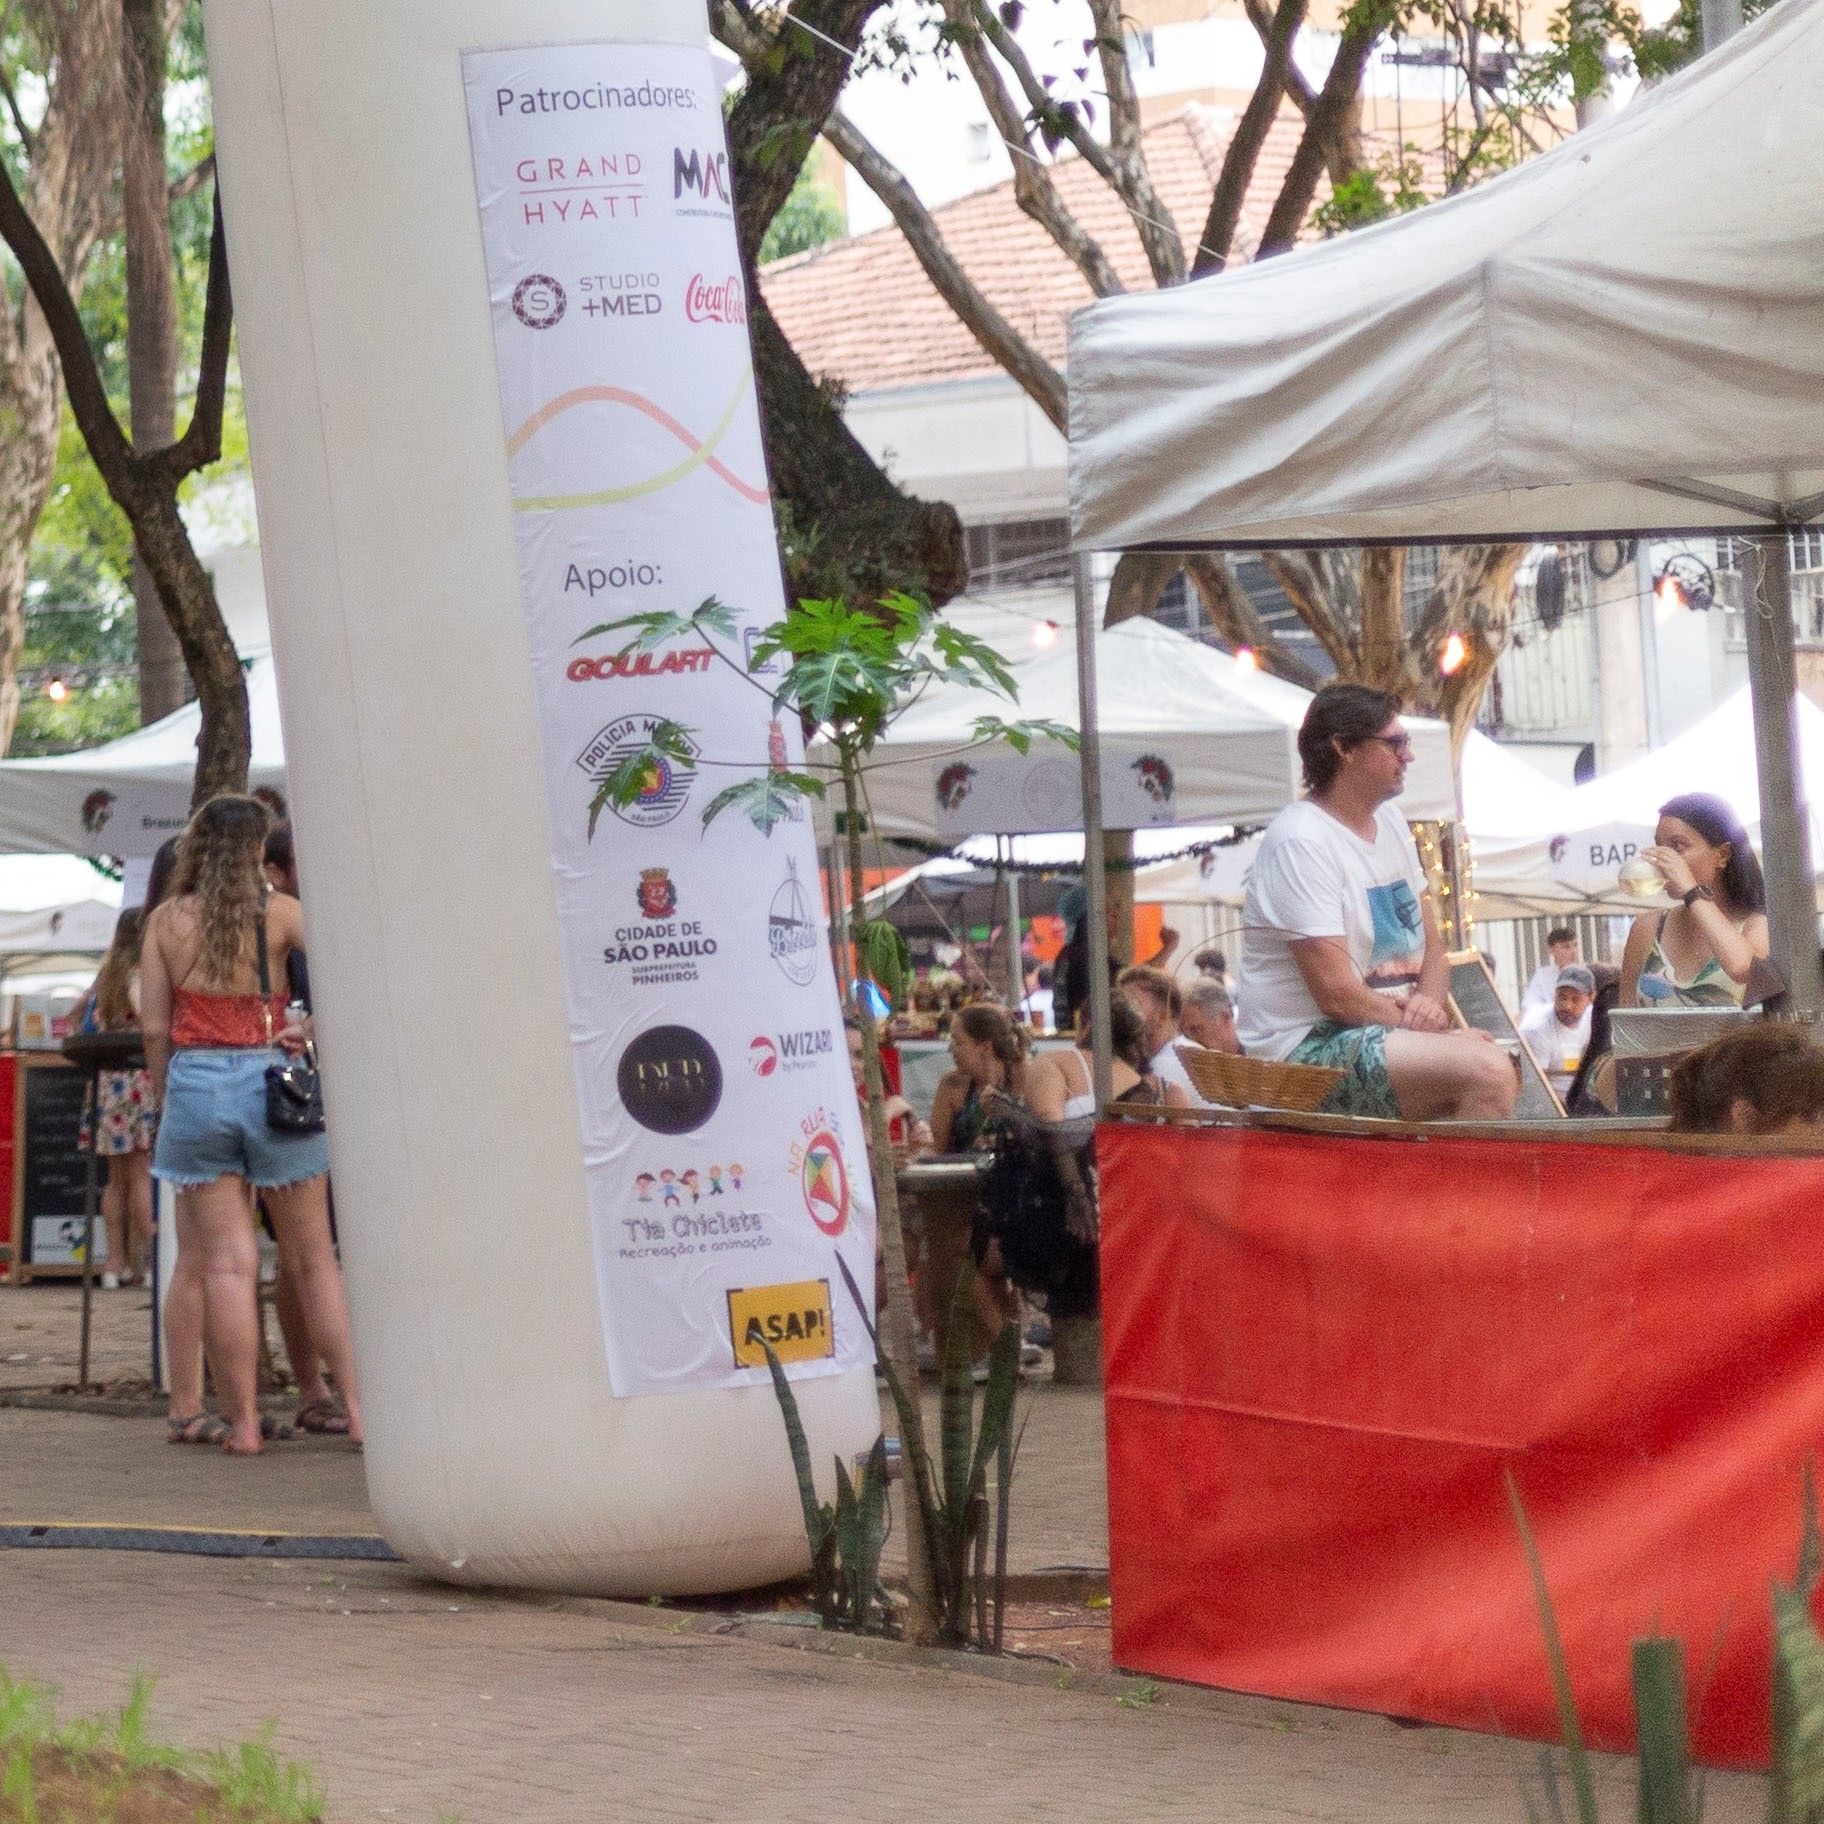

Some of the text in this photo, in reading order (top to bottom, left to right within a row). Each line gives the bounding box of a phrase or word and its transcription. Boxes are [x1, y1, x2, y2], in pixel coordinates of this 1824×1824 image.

[497, 80, 697, 116] Patrocinadores:
[516, 153, 642, 183] GRAND
[523, 195, 642, 225] HYATT
[579, 273, 660, 292] STUDIO
[582, 294, 662, 318] +MED
[564, 559, 664, 597] Apoio:
[566, 648, 716, 682] GOULART
[615, 921, 703, 942] CIDADE DE
[604, 938, 718, 964] SÃO PAULO
[632, 970, 700, 986] PINHEIROS
[711, 1234, 772, 1251] animação
[744, 1308, 826, 1347] ASAP!
